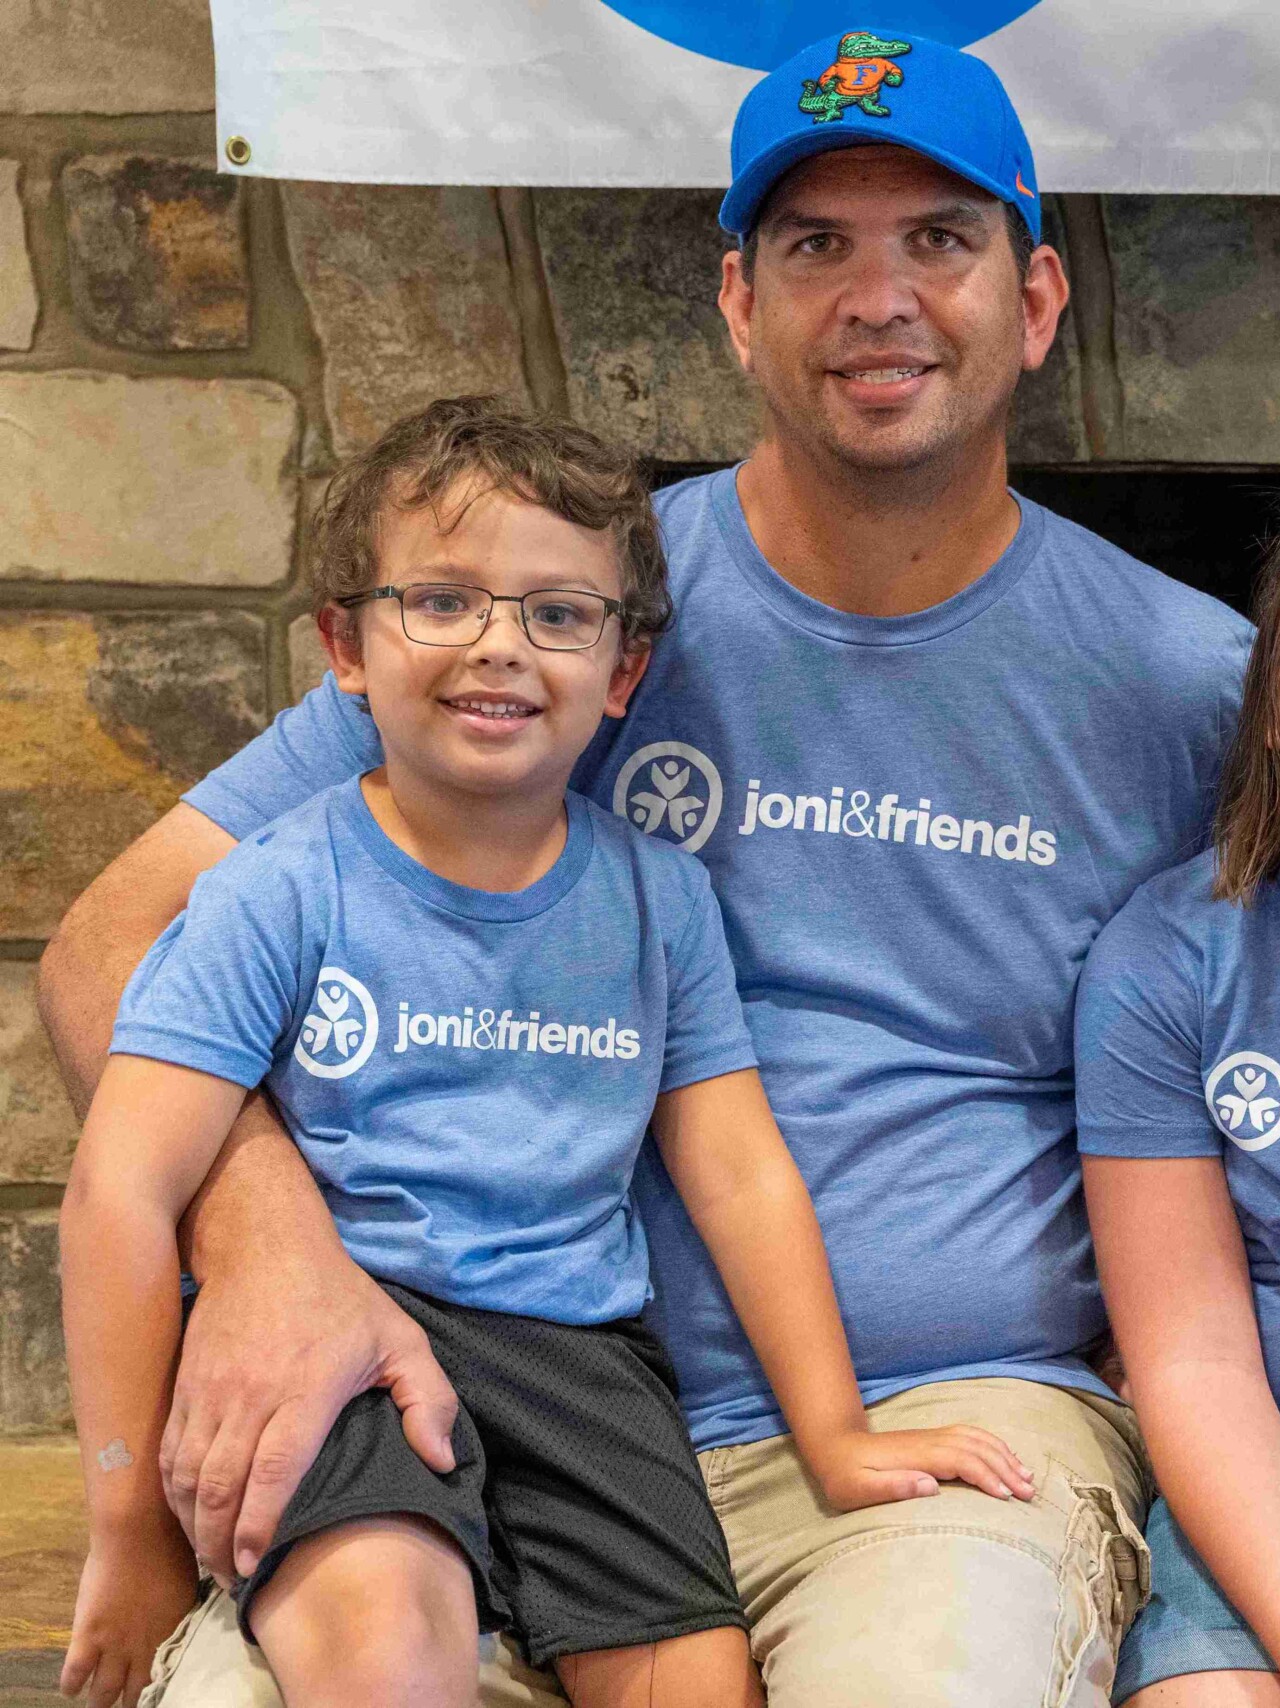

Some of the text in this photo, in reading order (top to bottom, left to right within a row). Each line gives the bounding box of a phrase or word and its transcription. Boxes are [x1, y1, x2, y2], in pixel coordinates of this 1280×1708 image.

[852, 65, 878, 85] F
[738, 779, 1057, 866] joni&friends
[393, 1001, 641, 1060] joni&friends
